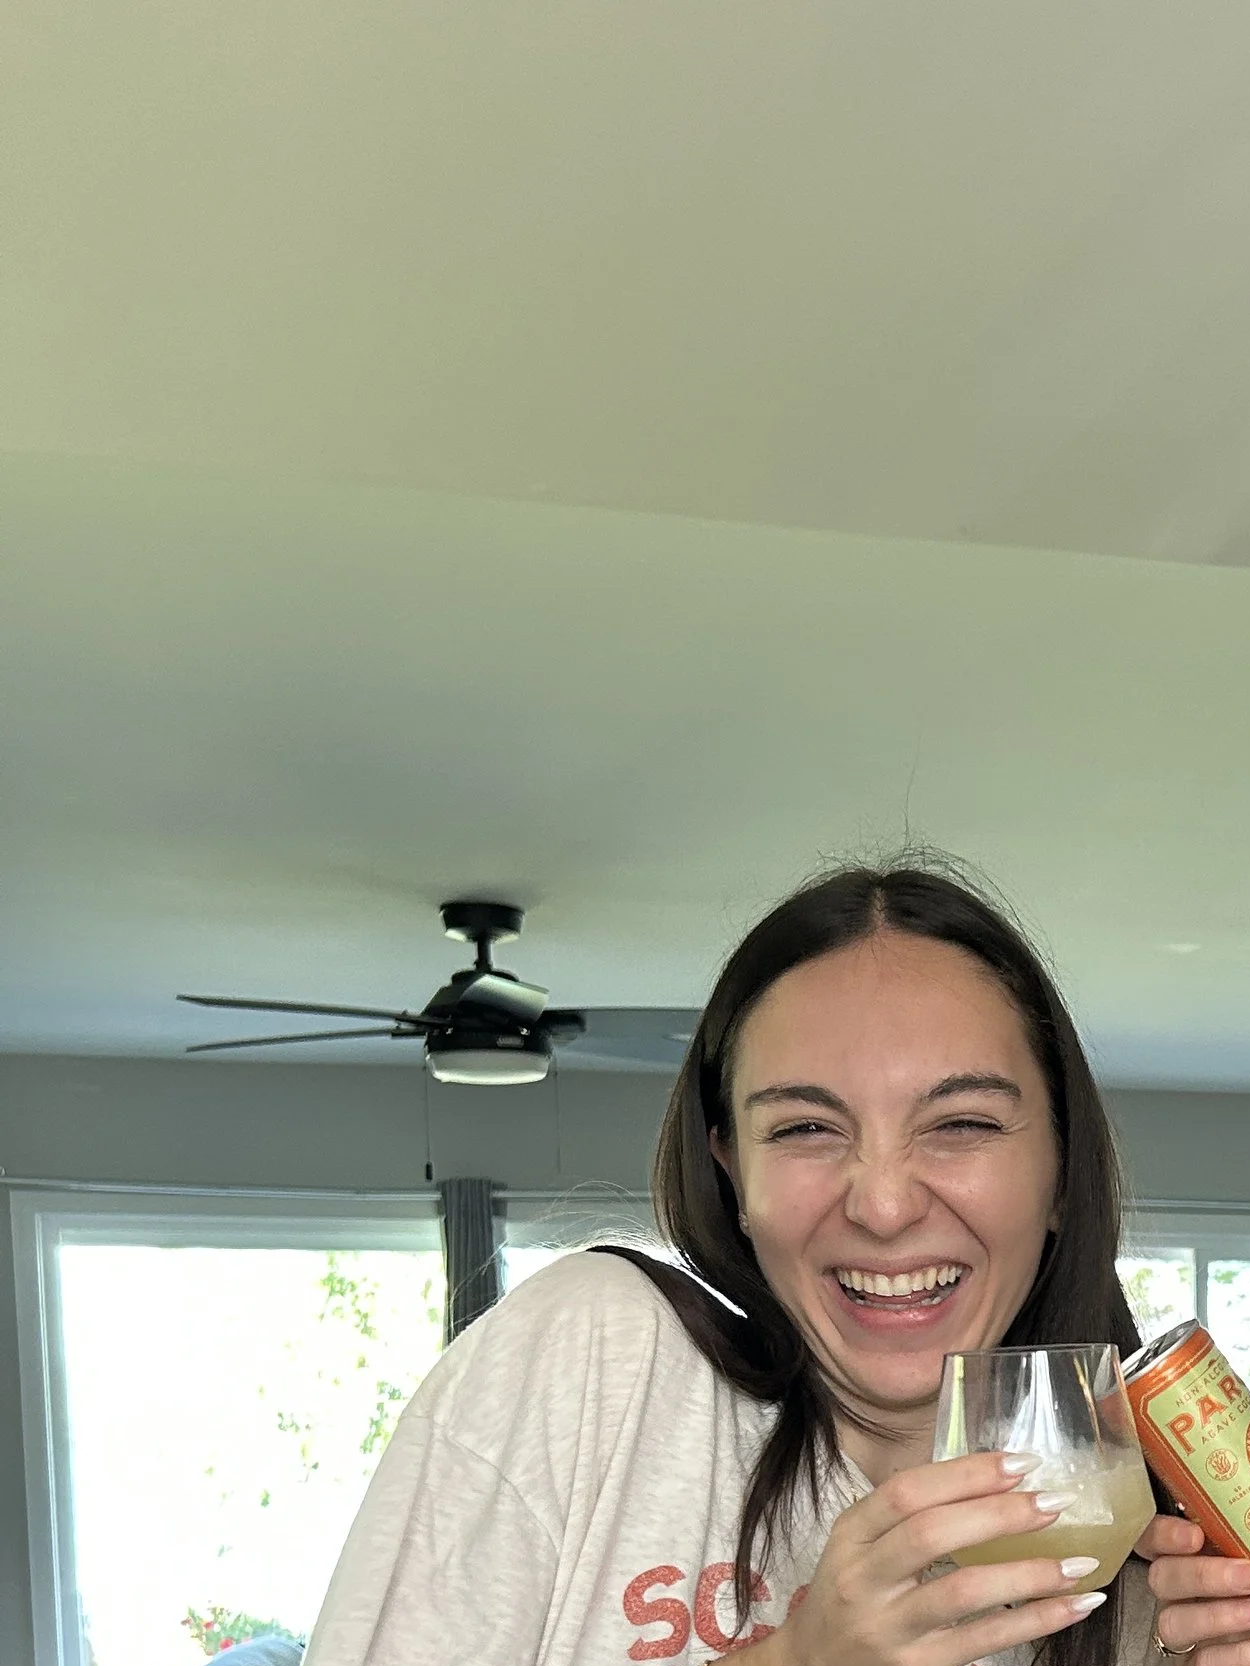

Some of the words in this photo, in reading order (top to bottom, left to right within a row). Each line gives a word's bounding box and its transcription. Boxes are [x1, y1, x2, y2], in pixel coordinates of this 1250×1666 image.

[1175, 1361, 1227, 1408] NON-ALCO
[1165, 1374, 1244, 1456] PAR
[1201, 1412, 1237, 1445] AGAVE
